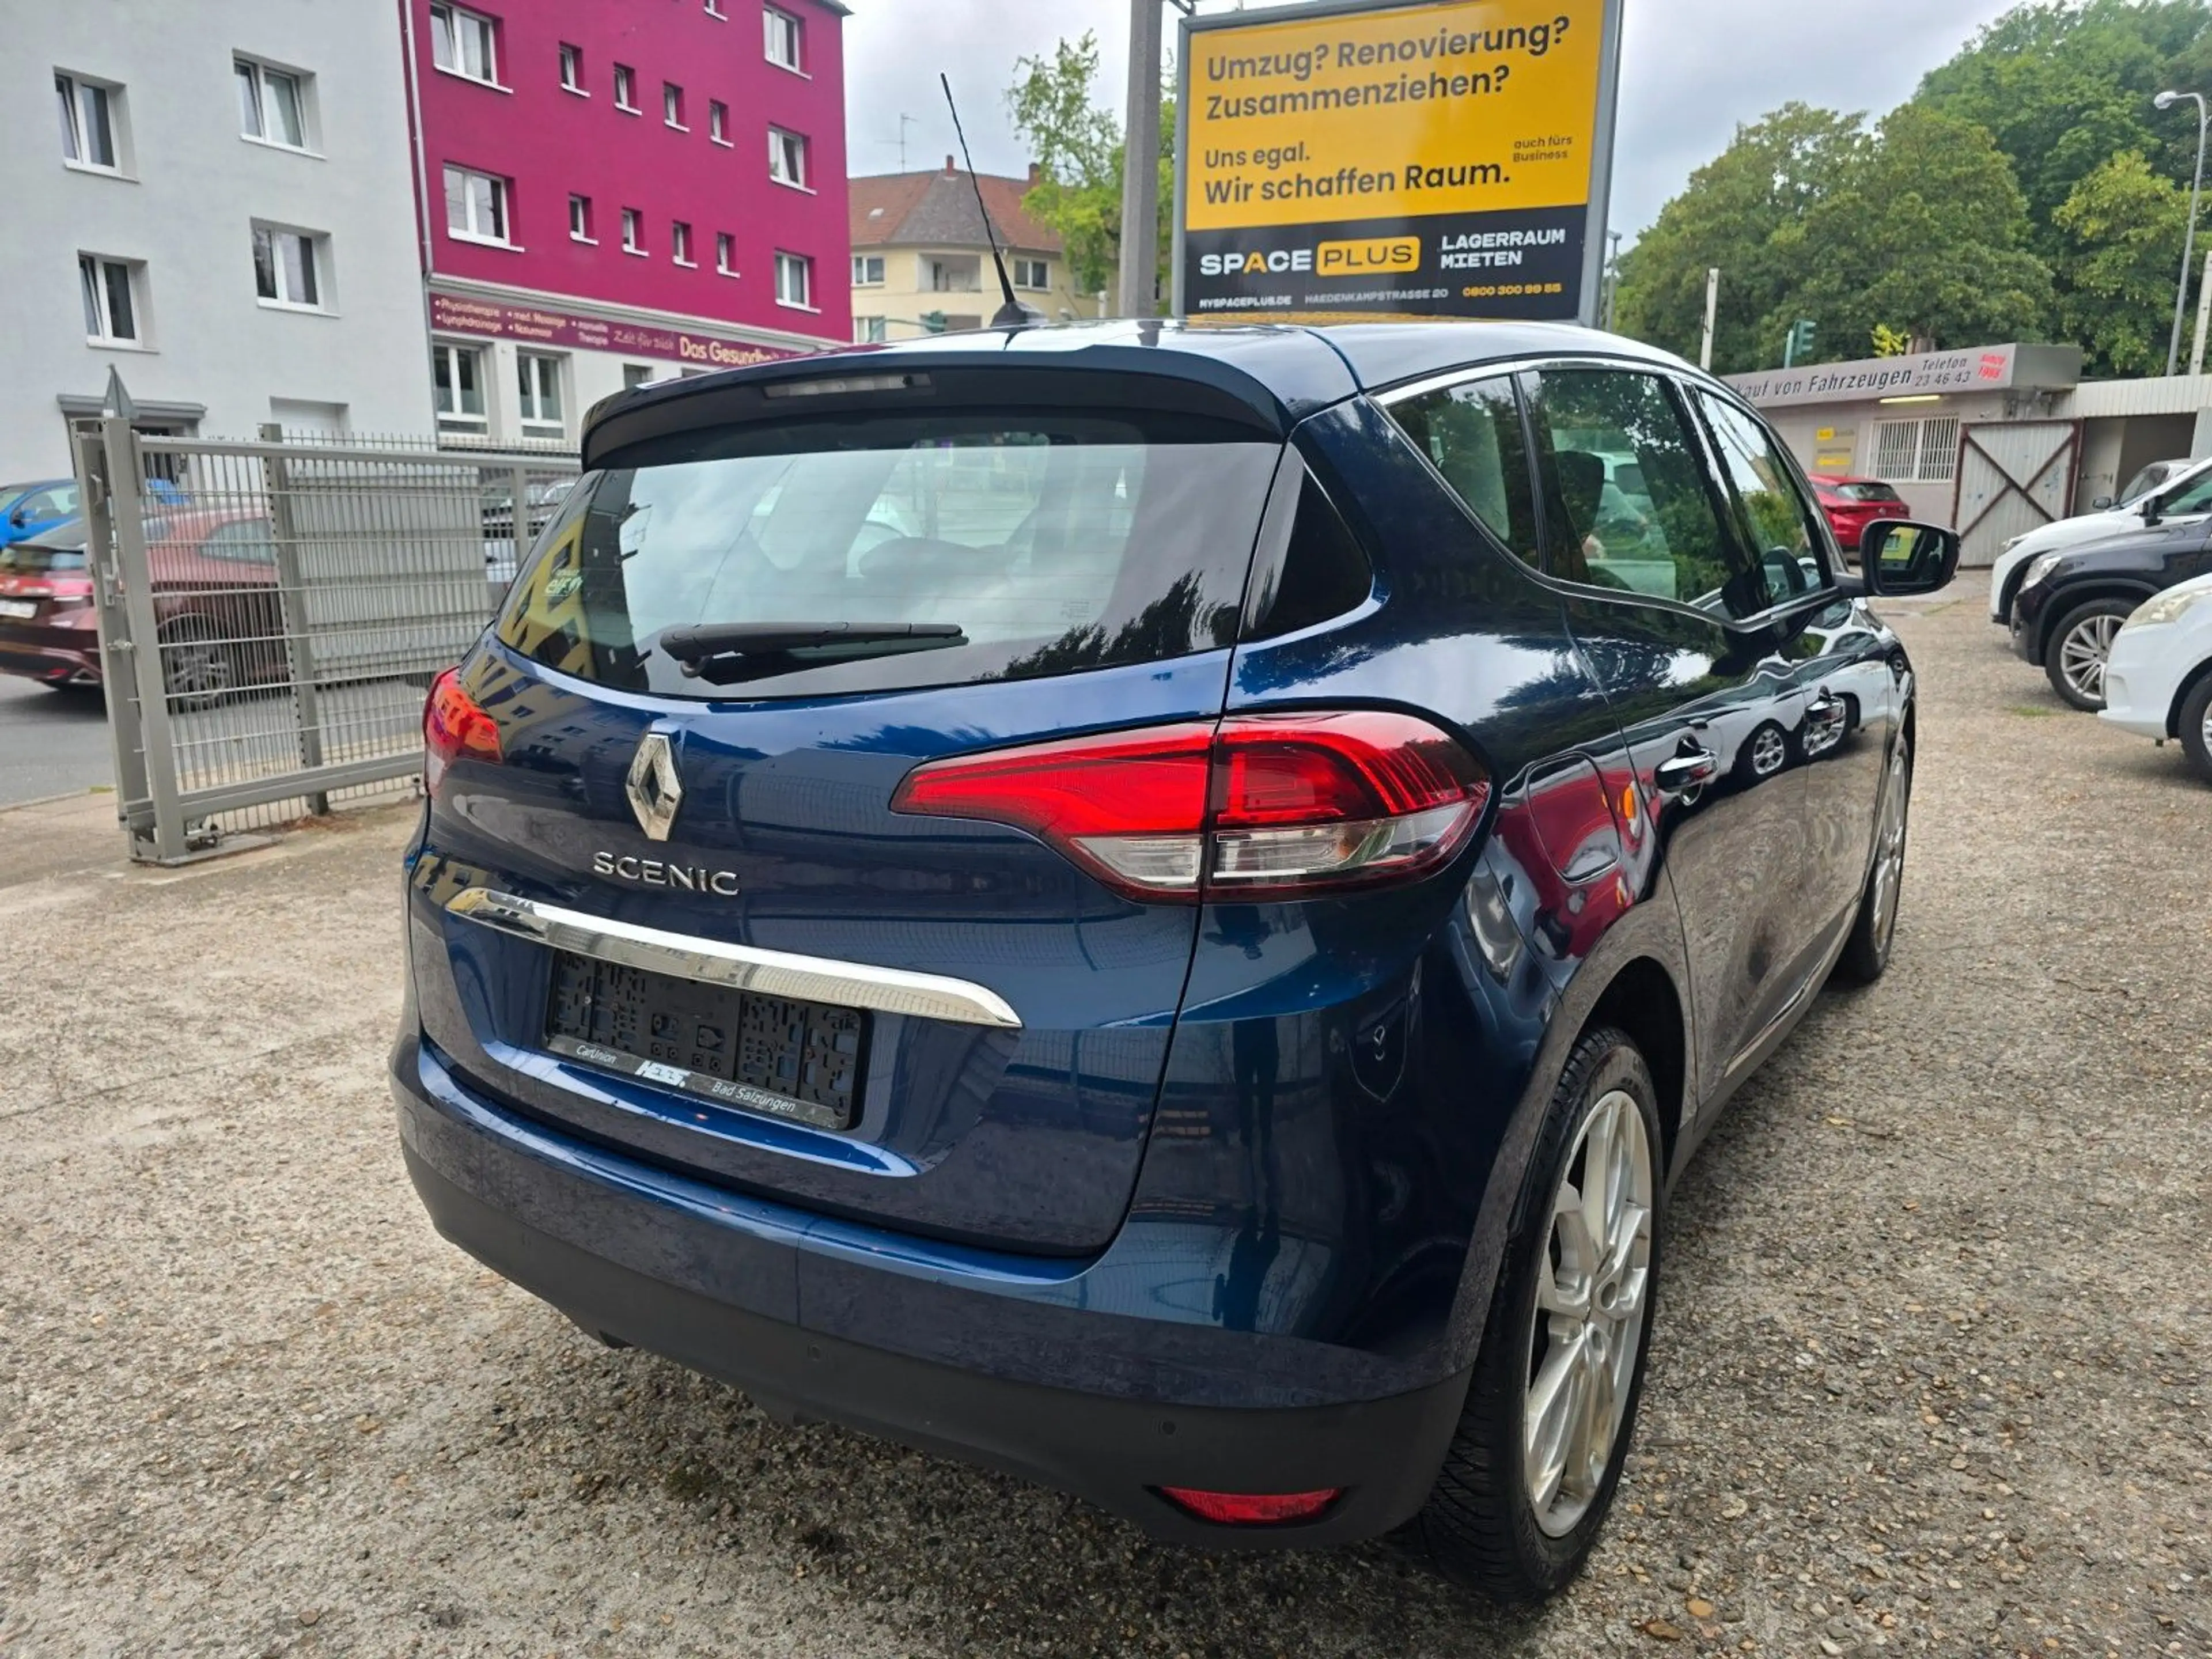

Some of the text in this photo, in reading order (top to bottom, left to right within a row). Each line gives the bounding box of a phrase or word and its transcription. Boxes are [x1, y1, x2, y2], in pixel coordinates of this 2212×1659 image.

[1207, 16, 1570, 81] Umzug? Renovierung?
[1207, 65, 1509, 120] Zusammenziehen?
[1514, 137, 1545, 149] auch
[1205, 142, 1310, 170] Uns egal.
[1513, 149, 1568, 162] Business
[1205, 162, 1510, 204] Wir schaffen Raum.
[1442, 229, 1565, 250] LAGERRAUM
[1200, 245, 1412, 275] SPACE PLUS
[1440, 251, 1522, 269] MIETEN
[1199, 296, 1292, 308] MYSPACEPLUS.DE
[679, 336, 707, 358] Das
[1922, 355, 1967, 371] Telefon
[1774, 380, 1802, 396] von
[1808, 369, 1912, 393] Fahrzeugen
[1915, 373, 1930, 387] 23
[1954, 370, 1971, 383] 43
[593, 851, 739, 896] SCENIC
[711, 1081, 736, 1096] Bad
[736, 1088, 796, 1113] Salzungen
